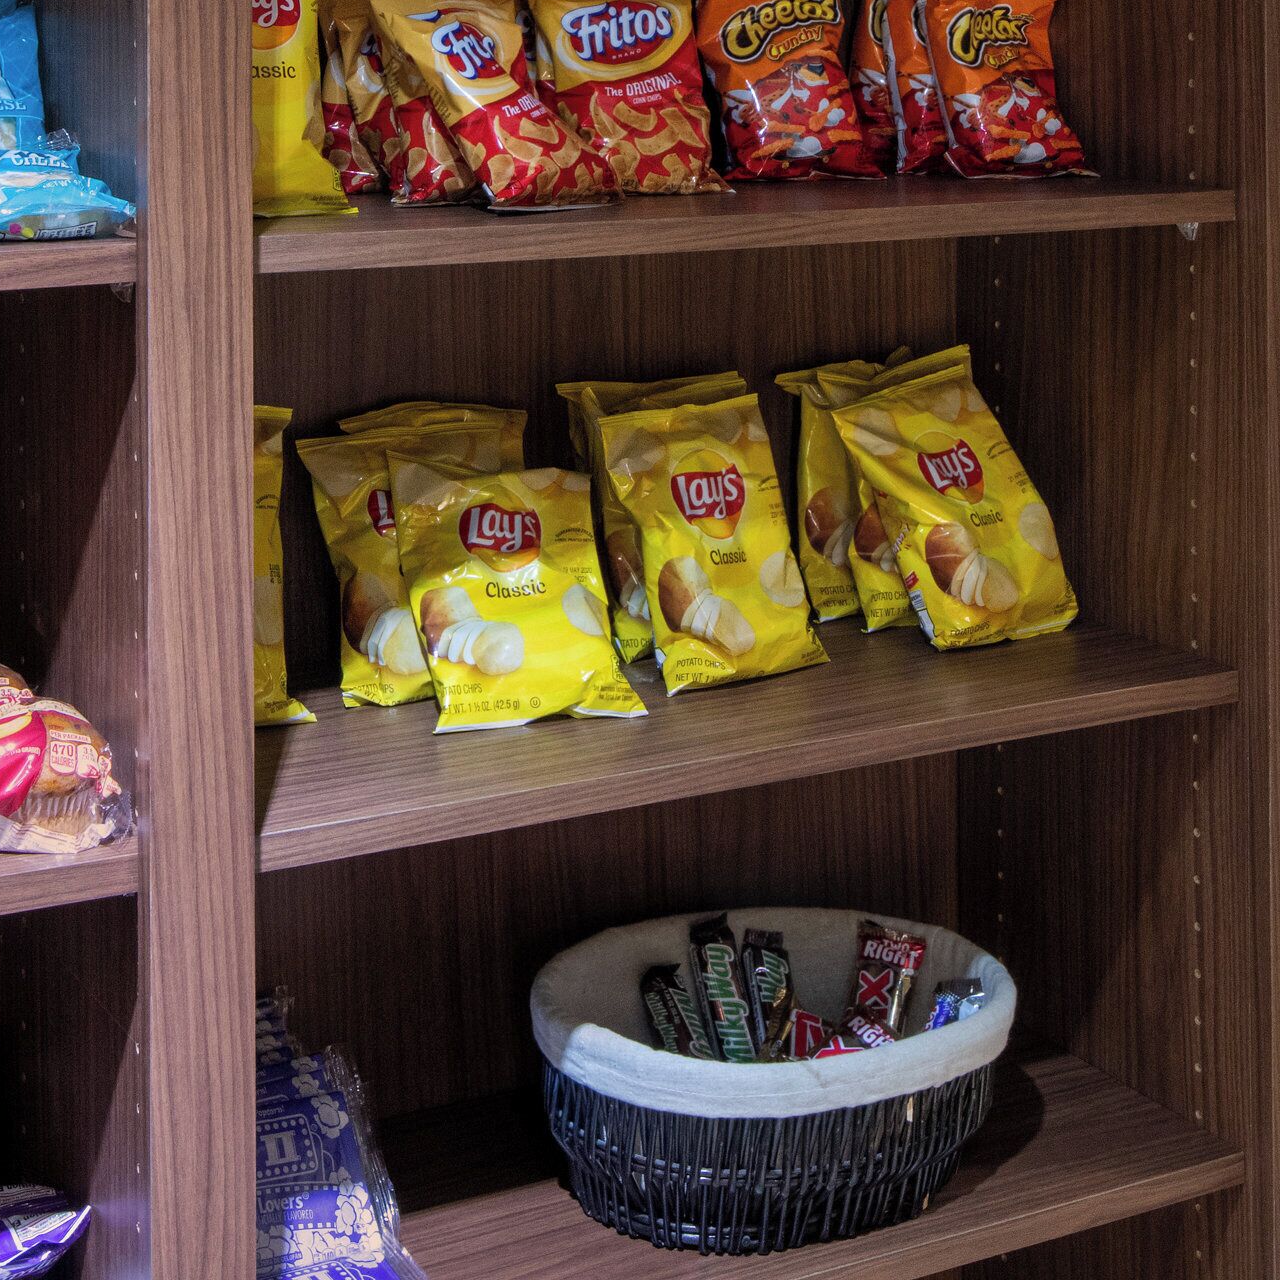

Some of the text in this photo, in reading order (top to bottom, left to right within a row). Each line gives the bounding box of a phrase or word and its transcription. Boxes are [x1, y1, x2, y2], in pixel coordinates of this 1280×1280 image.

[561, 3, 674, 60] Fritos
[766, 25, 821, 60] Crunchy
[612, 49, 641, 60] BRAND
[605, 73, 681, 97] The ORIGINAL
[927, 444, 979, 488] Lay's
[677, 469, 738, 519] Lay's
[970, 509, 1003, 529] Classic
[467, 507, 536, 552] Lay's
[710, 547, 747, 566] Classic
[486, 580, 546, 599] Classic
[677, 658, 725, 670] POTATO CHIPS
[464, 684, 482, 693] CHIPS
[53, 743, 74, 755] 470
[52, 756, 74, 767] CALORIES
[864, 940, 918, 970] RIGHT
[883, 939, 910, 952] TWO
[260, 1192, 303, 1213] Lovers
